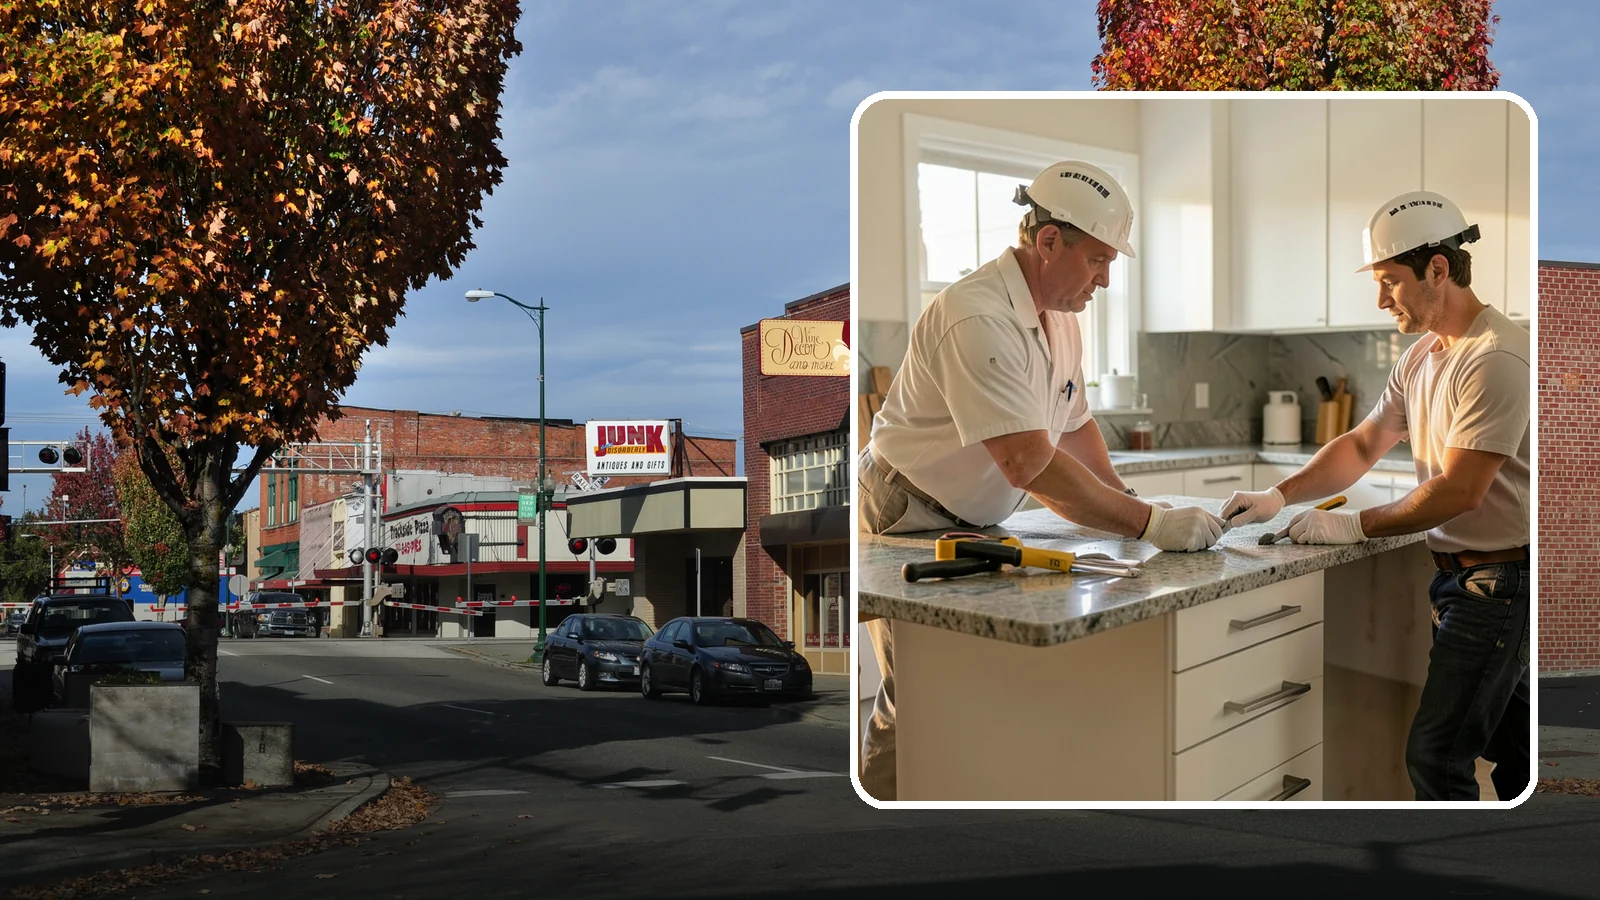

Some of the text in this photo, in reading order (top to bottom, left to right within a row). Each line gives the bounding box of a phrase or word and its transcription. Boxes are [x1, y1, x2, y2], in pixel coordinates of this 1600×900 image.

[765, 328, 831, 365] Decor
[595, 425, 665, 457] JUNK
[607, 446, 645, 454] DISORDERLY
[597, 460, 665, 470] ANTIQUES AND GIFTS
